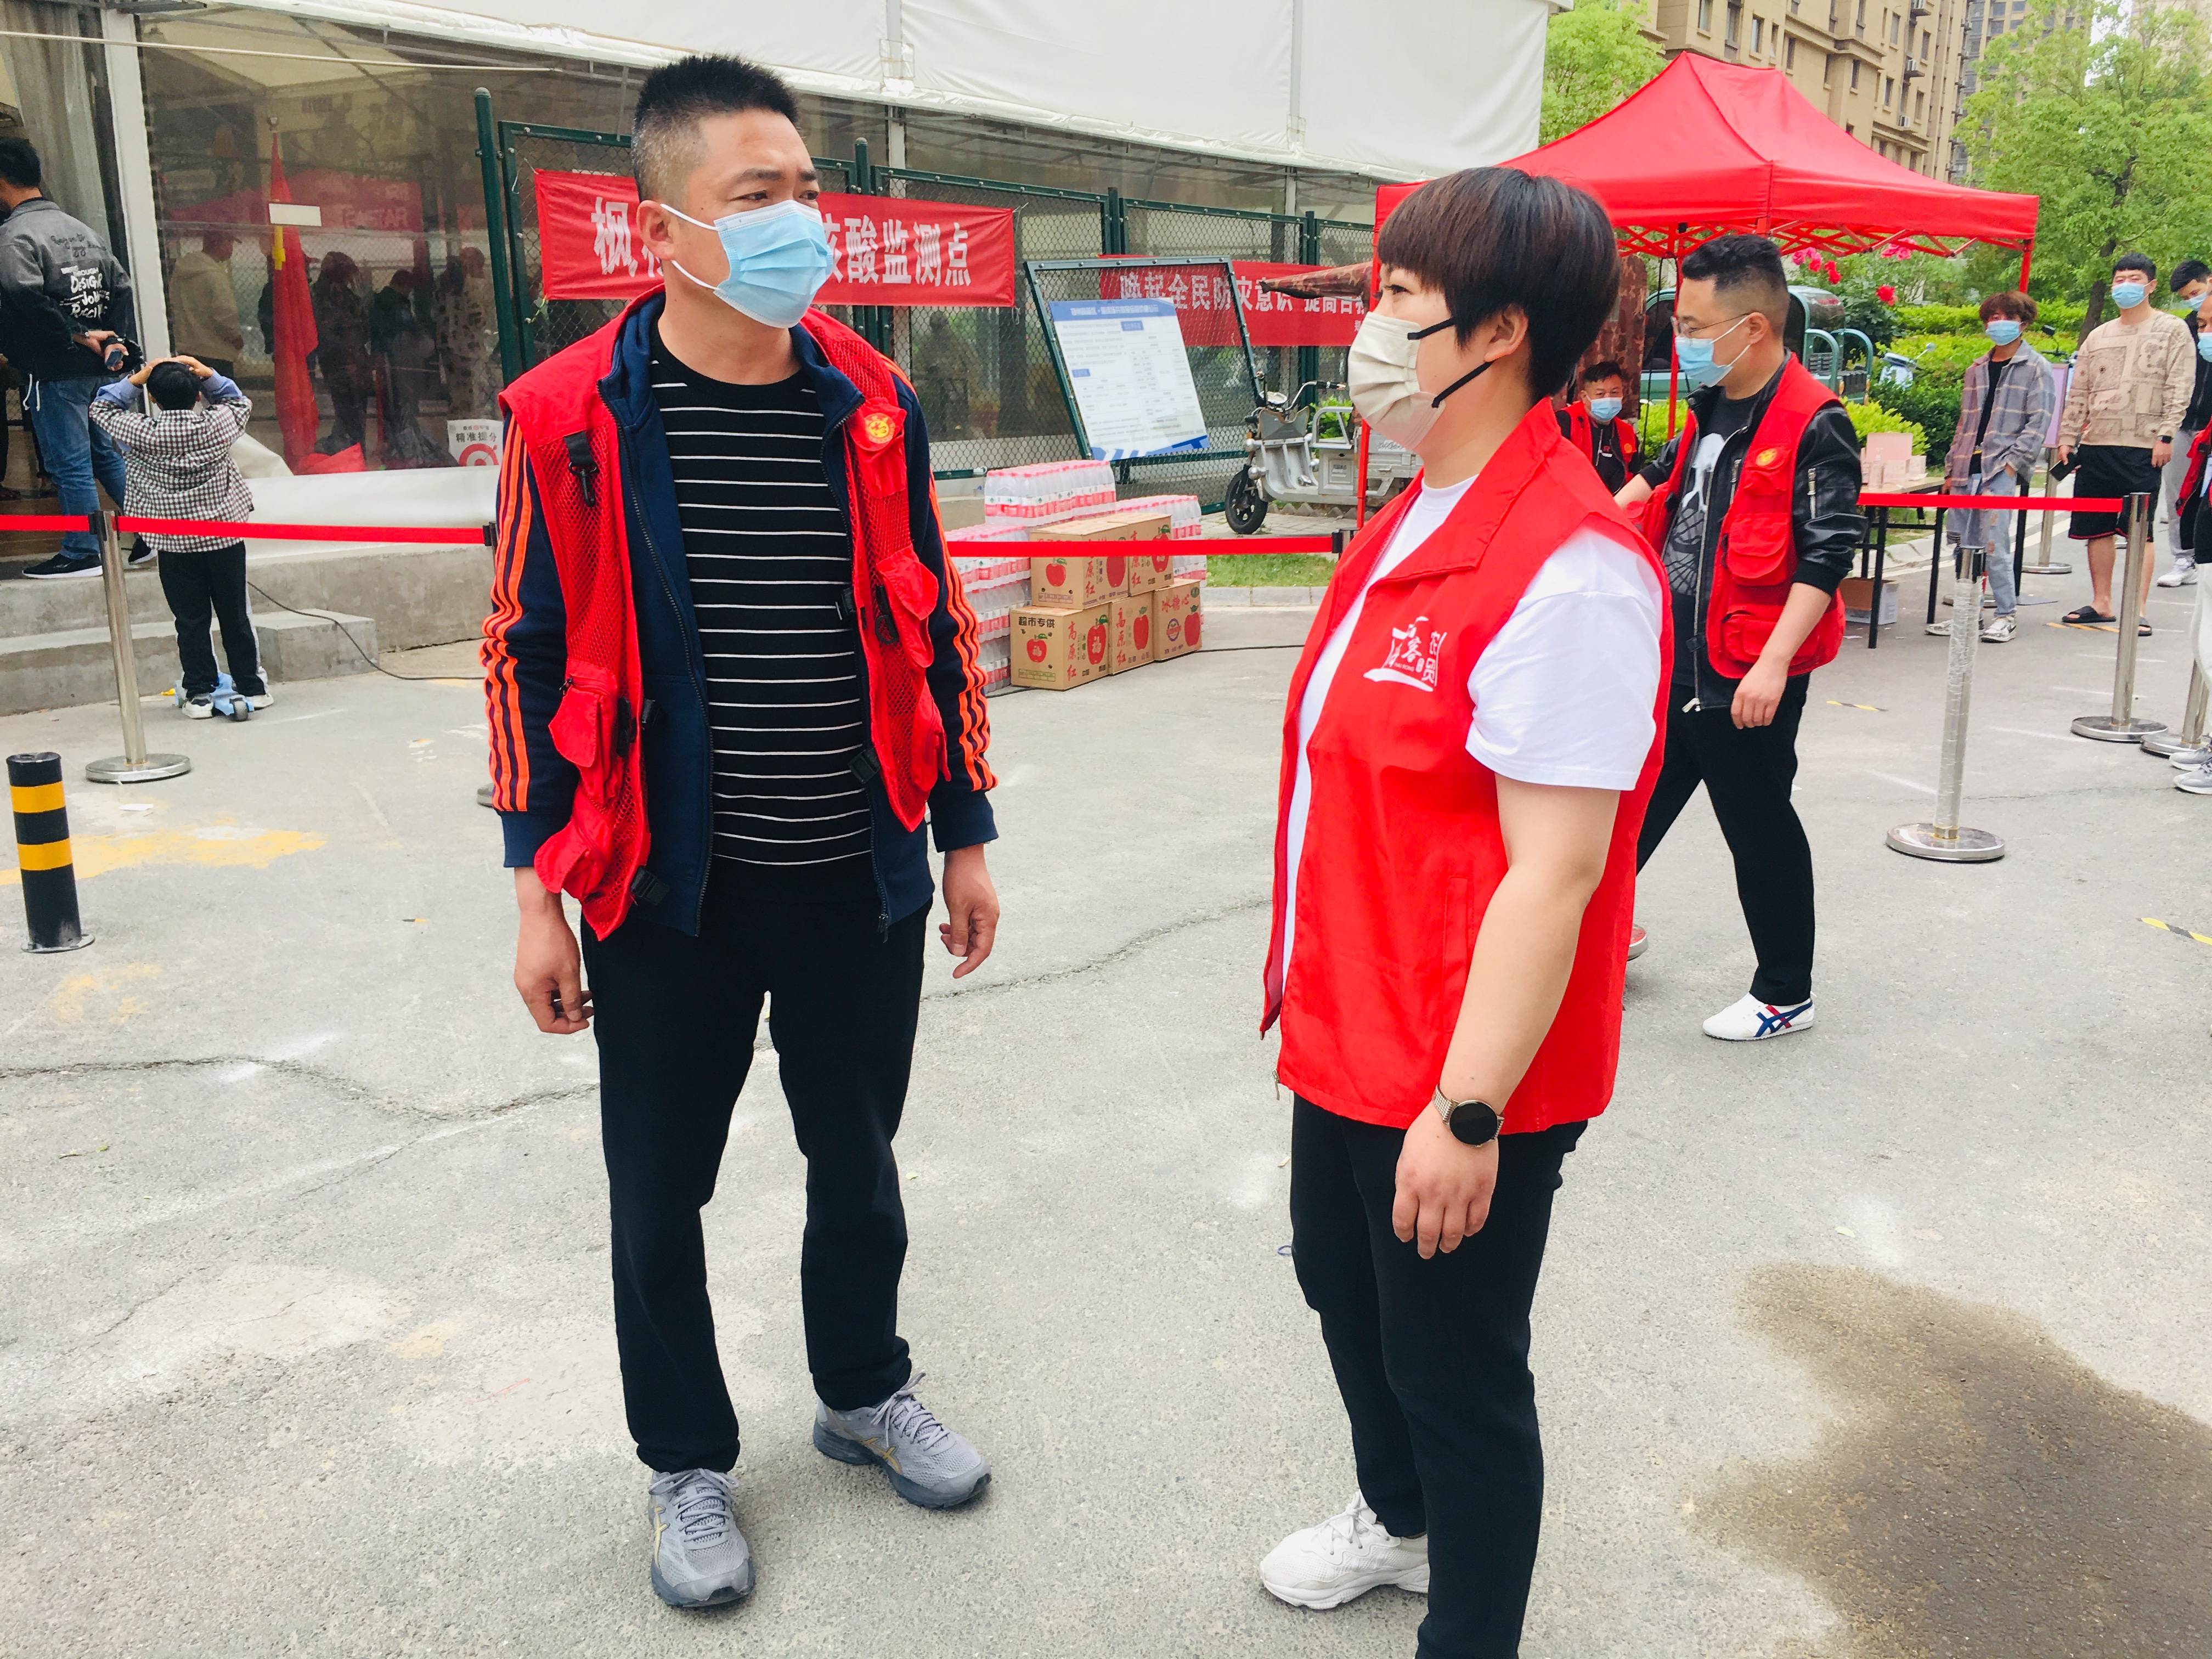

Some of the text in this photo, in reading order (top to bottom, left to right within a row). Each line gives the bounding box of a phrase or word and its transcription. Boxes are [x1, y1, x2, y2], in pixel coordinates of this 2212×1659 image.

[1018, 616, 1056, 629] 超市专供
[1066, 620, 1077, 681] 高原红
